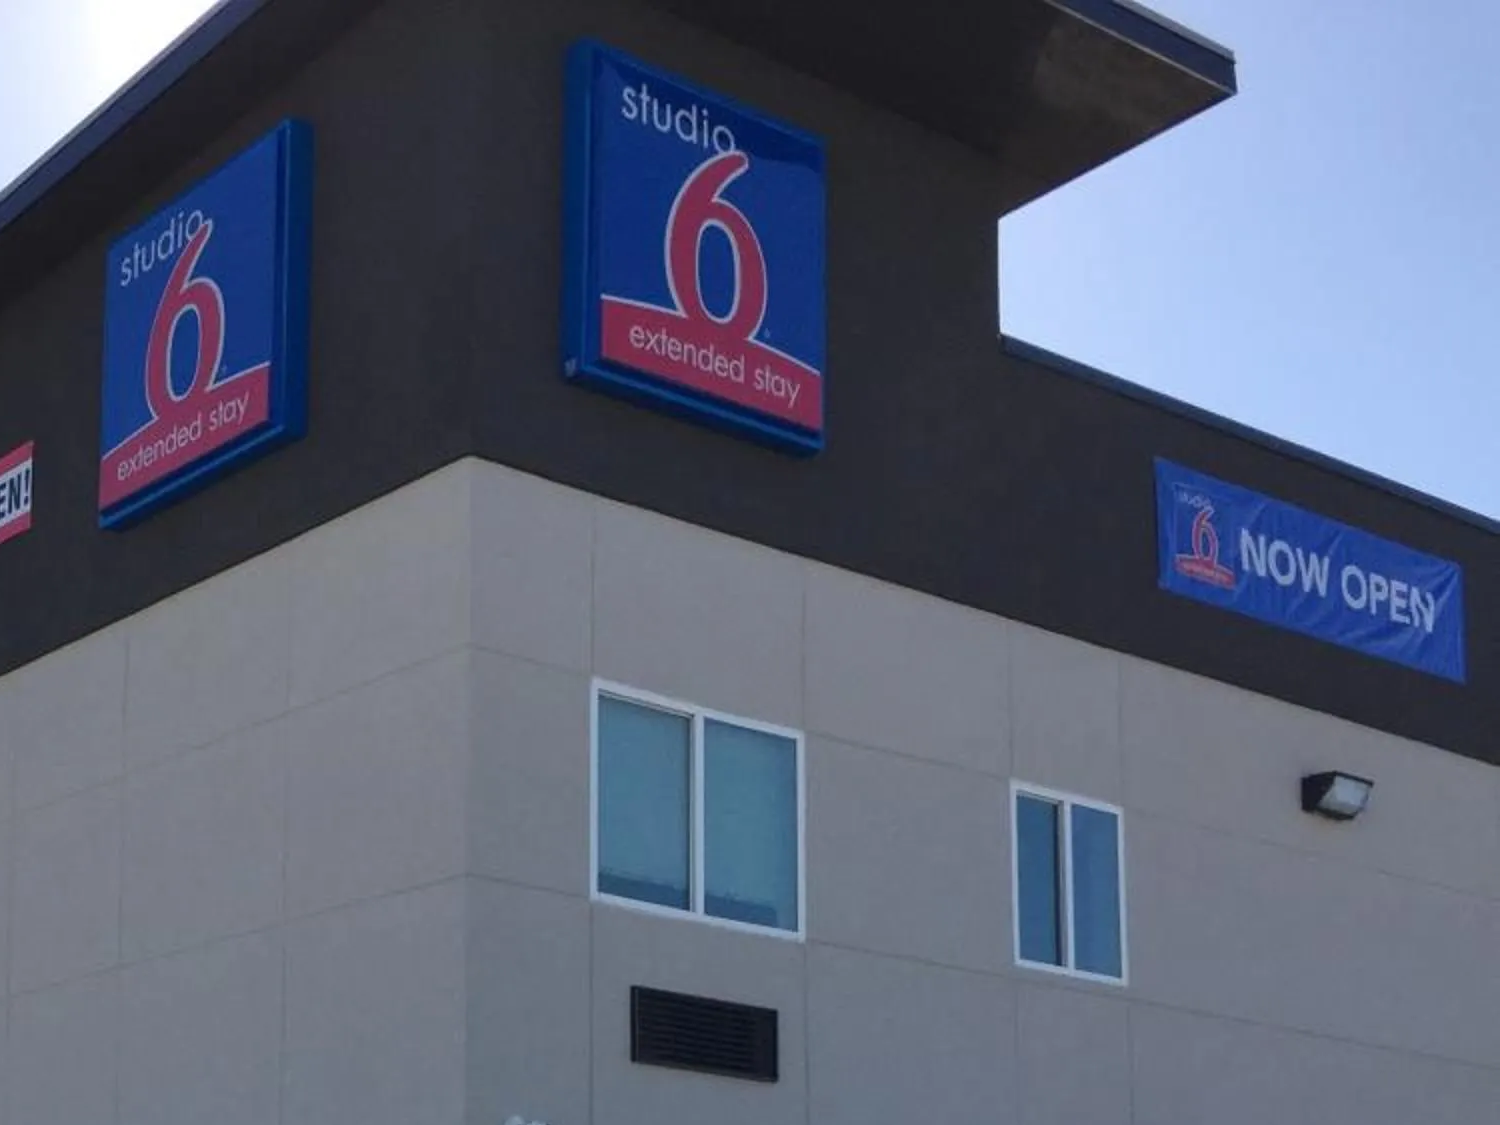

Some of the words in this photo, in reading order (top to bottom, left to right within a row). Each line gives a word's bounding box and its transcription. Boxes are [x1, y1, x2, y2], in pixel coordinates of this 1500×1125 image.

[621, 82, 736, 153] studio
[119, 209, 205, 287] studio
[664, 150, 768, 336] 6
[145, 219, 226, 418] 6
[629, 322, 746, 384] extended
[754, 364, 801, 409] stay
[117, 417, 202, 482] extended
[208, 391, 250, 432] stay
[1240, 527, 1331, 598] NOW
[1341, 564, 1436, 633] OPEN
